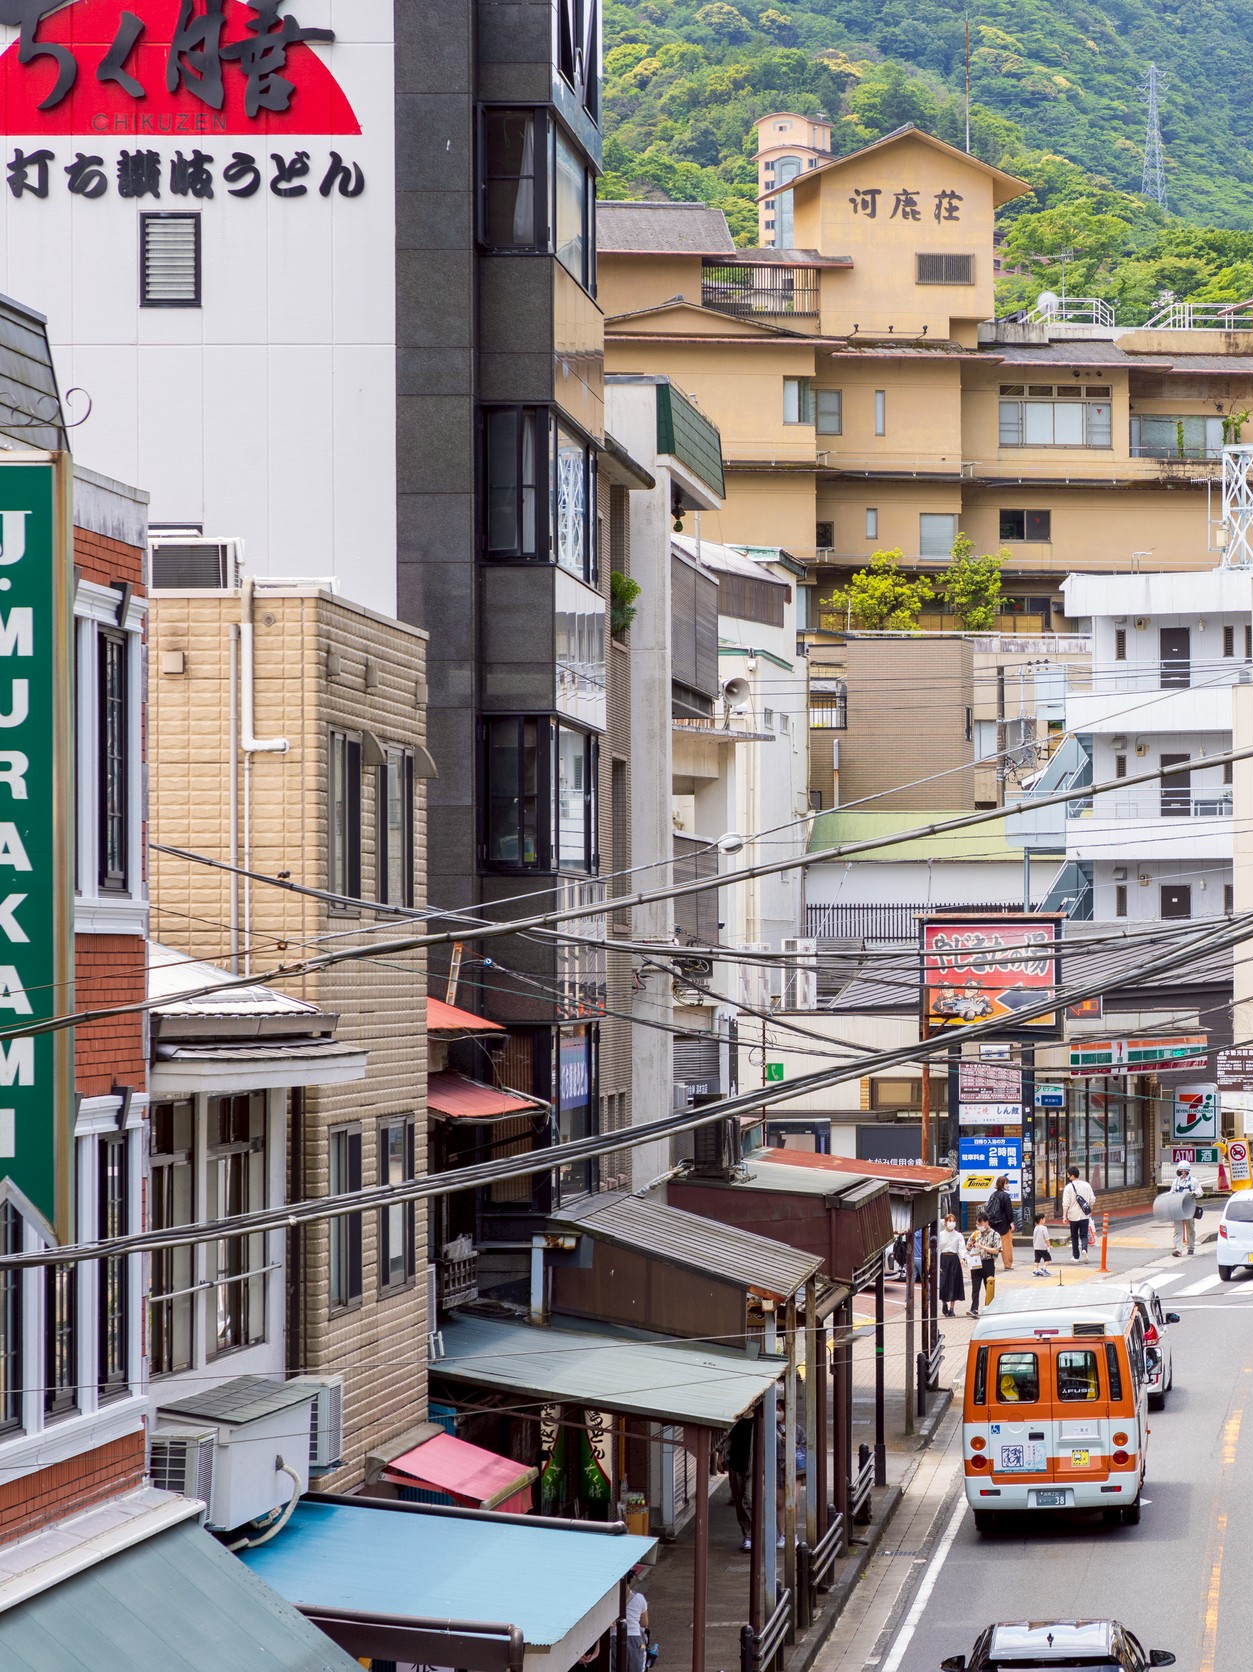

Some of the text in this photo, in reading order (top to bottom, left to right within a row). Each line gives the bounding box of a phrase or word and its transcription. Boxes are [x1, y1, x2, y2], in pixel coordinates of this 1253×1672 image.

[92, 113, 227, 131] CHIKUZEN
[848, 188, 964, 225] 河鹿荘
[988, 1147, 1017, 1157] 2時間
[1174, 1149, 1194, 1162] ATM
[1201, 1149, 1213, 1162] 酒
[1055, 1496, 1065, 1505] 38
